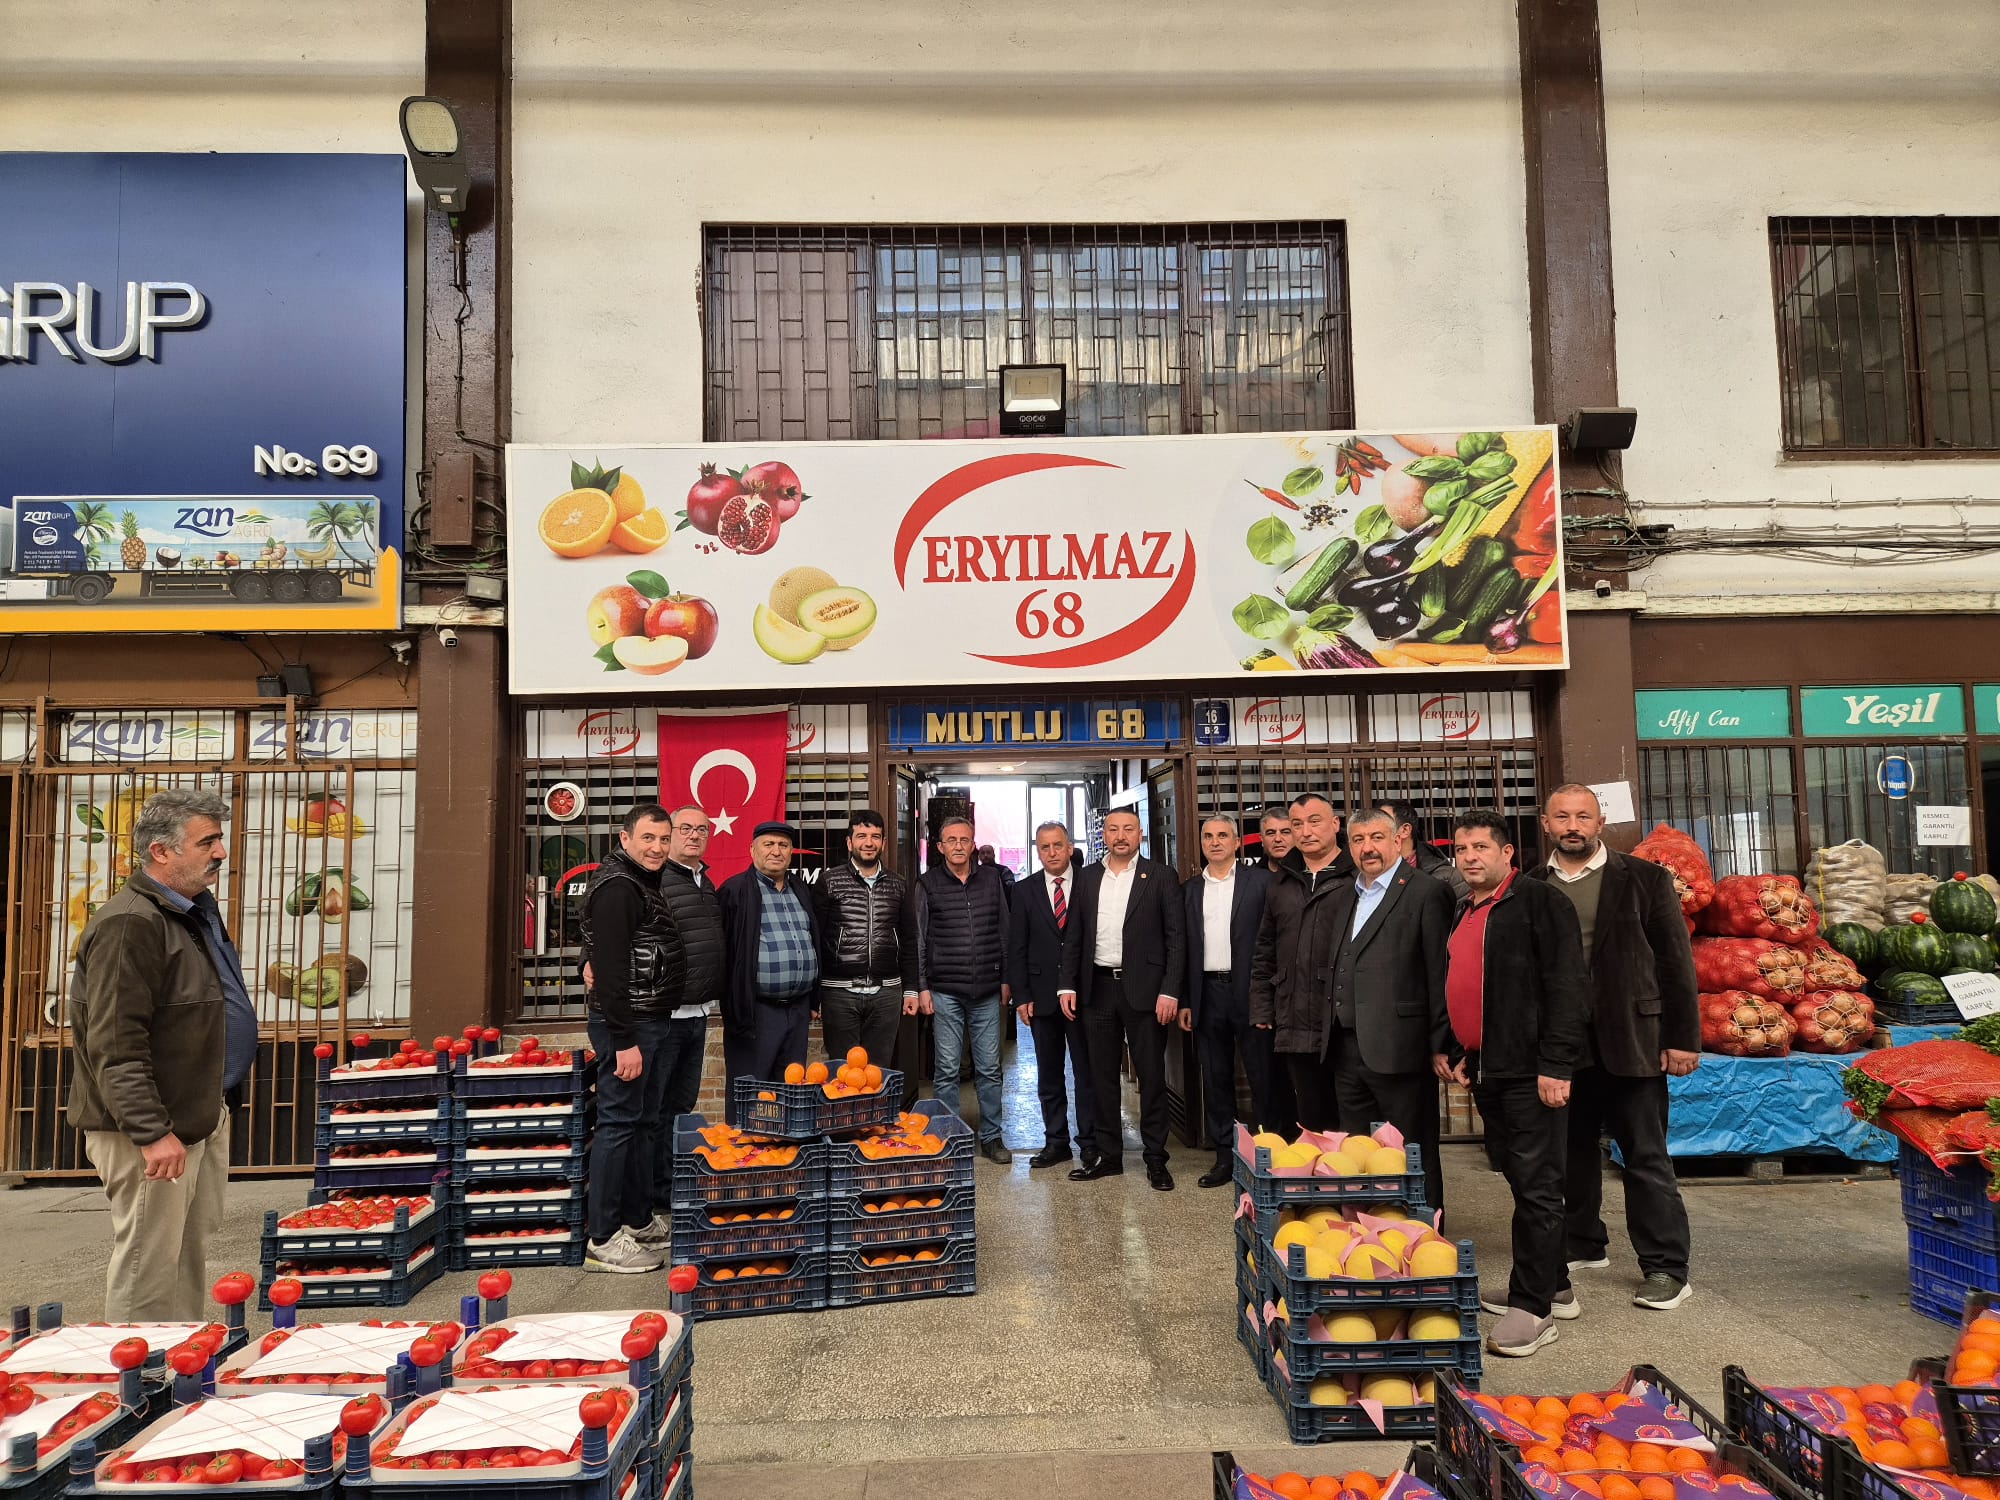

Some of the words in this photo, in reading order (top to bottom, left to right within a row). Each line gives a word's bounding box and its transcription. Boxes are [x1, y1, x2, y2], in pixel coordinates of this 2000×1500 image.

[254, 444, 318, 477] No:
[322, 444, 378, 476] 69
[23, 511, 52, 525] zan
[174, 507, 234, 537] zan
[922, 530, 1175, 583] ERYILMAZ
[1015, 588, 1085, 639] 68
[1206, 709, 1218, 724] 16
[1444, 720, 1457, 730] 68
[1658, 709, 1700, 735] Afif
[1708, 709, 1740, 726] Can
[1843, 692, 1942, 728] Yeşil
[68, 718, 165, 758] zan
[927, 711, 1061, 743] MUTLU
[1097, 709, 1144, 739] 68
[1269, 724, 1281, 734] 68
